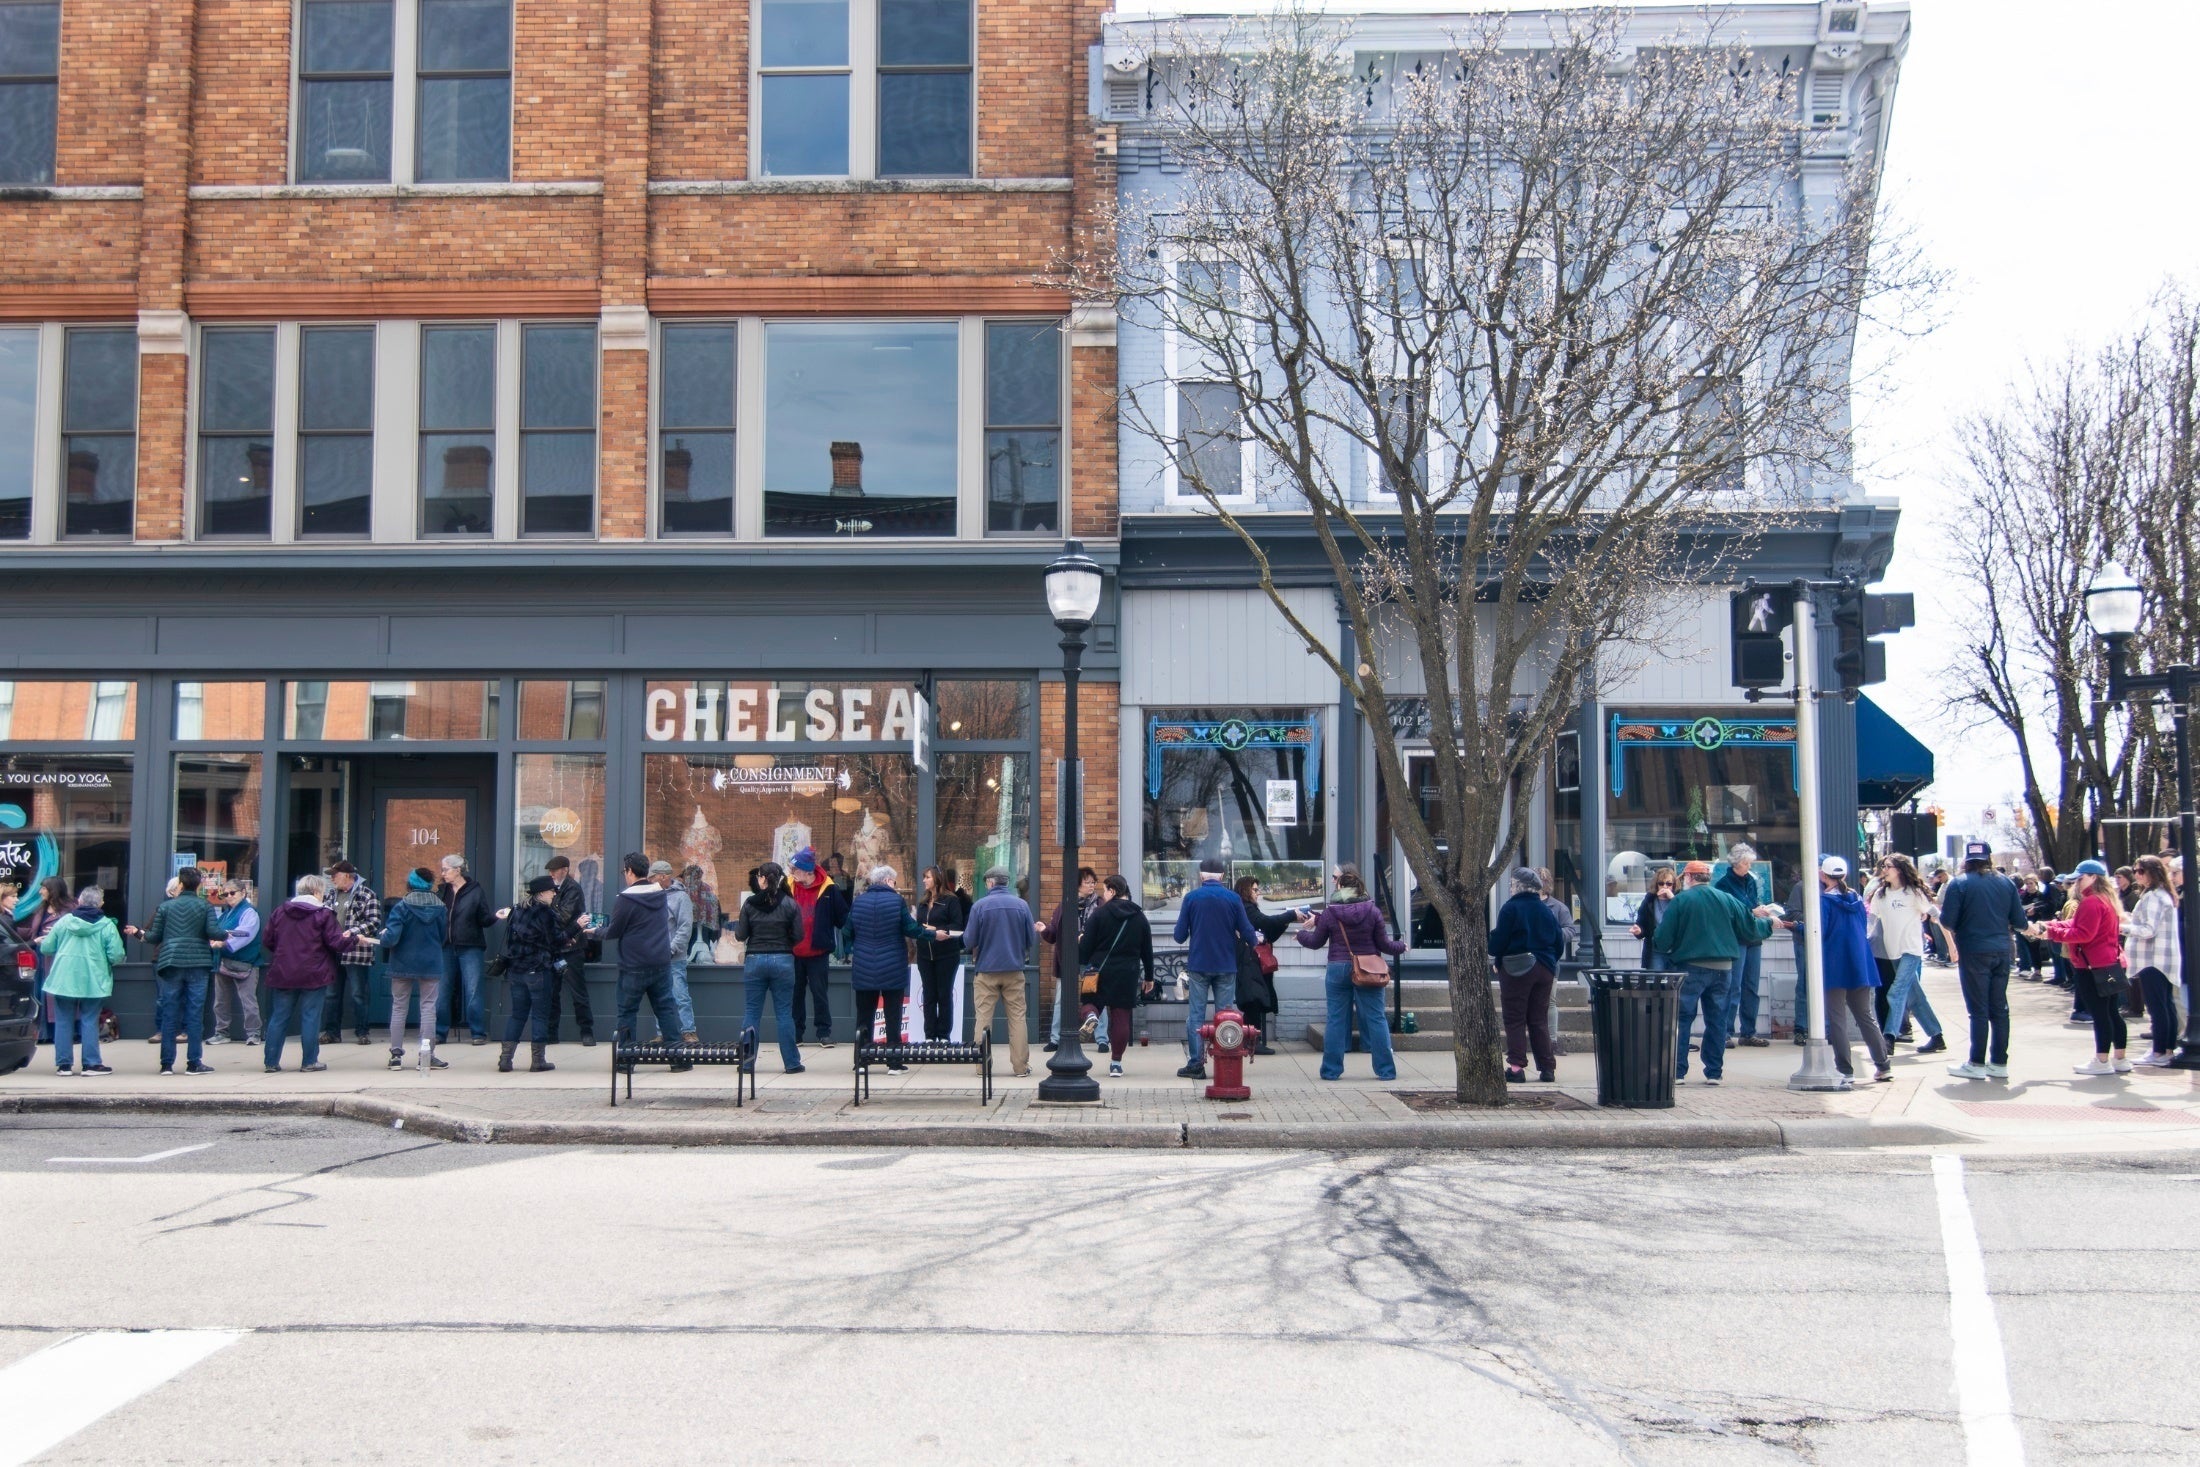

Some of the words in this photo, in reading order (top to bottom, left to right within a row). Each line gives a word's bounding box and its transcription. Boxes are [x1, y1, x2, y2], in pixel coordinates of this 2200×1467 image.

[646, 688, 915, 741] CHELSEA
[8, 774, 31, 783] YOU
[33, 774, 57, 783] CAN
[60, 774, 76, 783] DO
[79, 774, 112, 783] YOGA.
[730, 767, 835, 781] CONSIGNMENT
[761, 786, 783, 794] Apparel
[539, 819, 581, 837] open
[410, 828, 440, 845] 104
